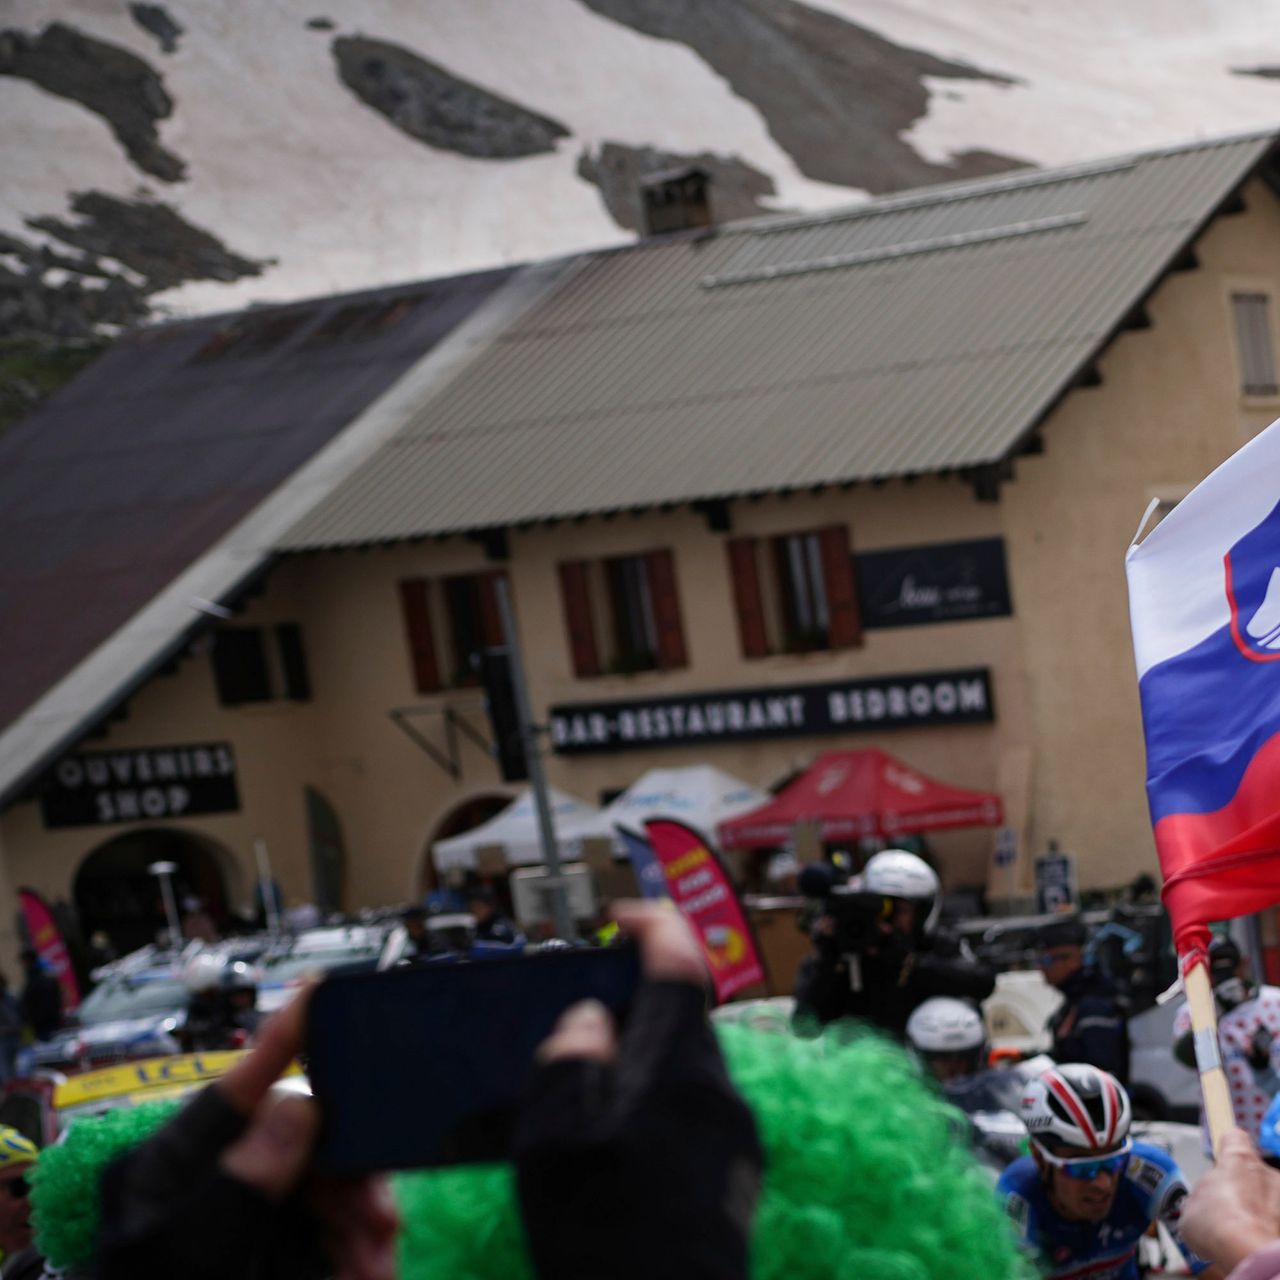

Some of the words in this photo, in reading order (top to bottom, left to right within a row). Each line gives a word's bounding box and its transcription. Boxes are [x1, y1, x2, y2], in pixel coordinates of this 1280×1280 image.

[551, 696, 806, 745] BAR-RESTAURANT
[827, 678, 985, 723] BEDROOM
[57, 747, 233, 787] OUVENIRS
